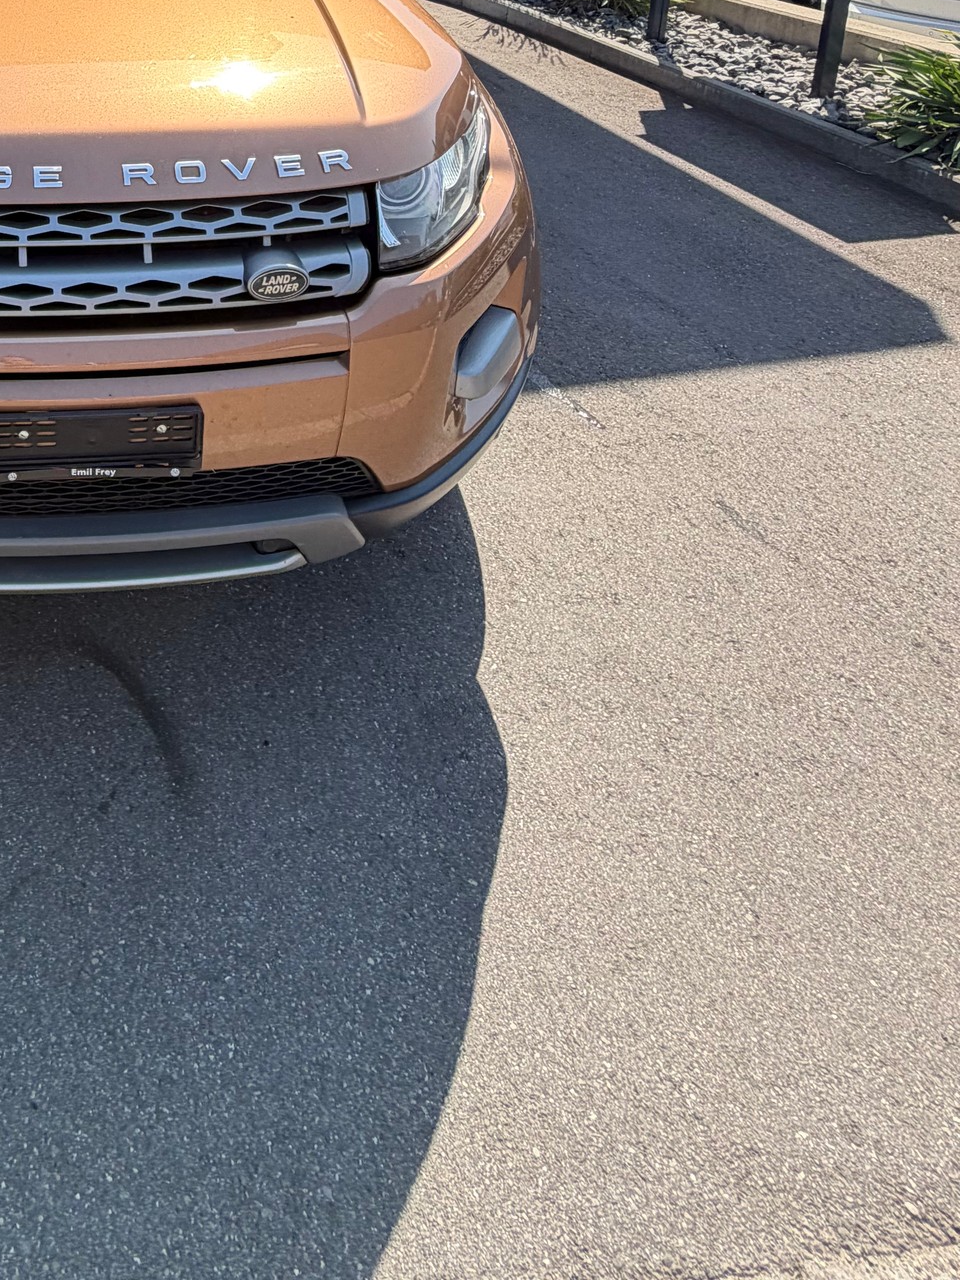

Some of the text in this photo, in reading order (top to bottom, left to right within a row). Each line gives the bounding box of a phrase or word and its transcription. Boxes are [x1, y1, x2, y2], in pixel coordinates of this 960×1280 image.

[121, 148, 354, 187] ROVER
[262, 274, 291, 286] LAND
[264, 282, 299, 295] ROVER
[71, 467, 116, 477] Emil Frey
